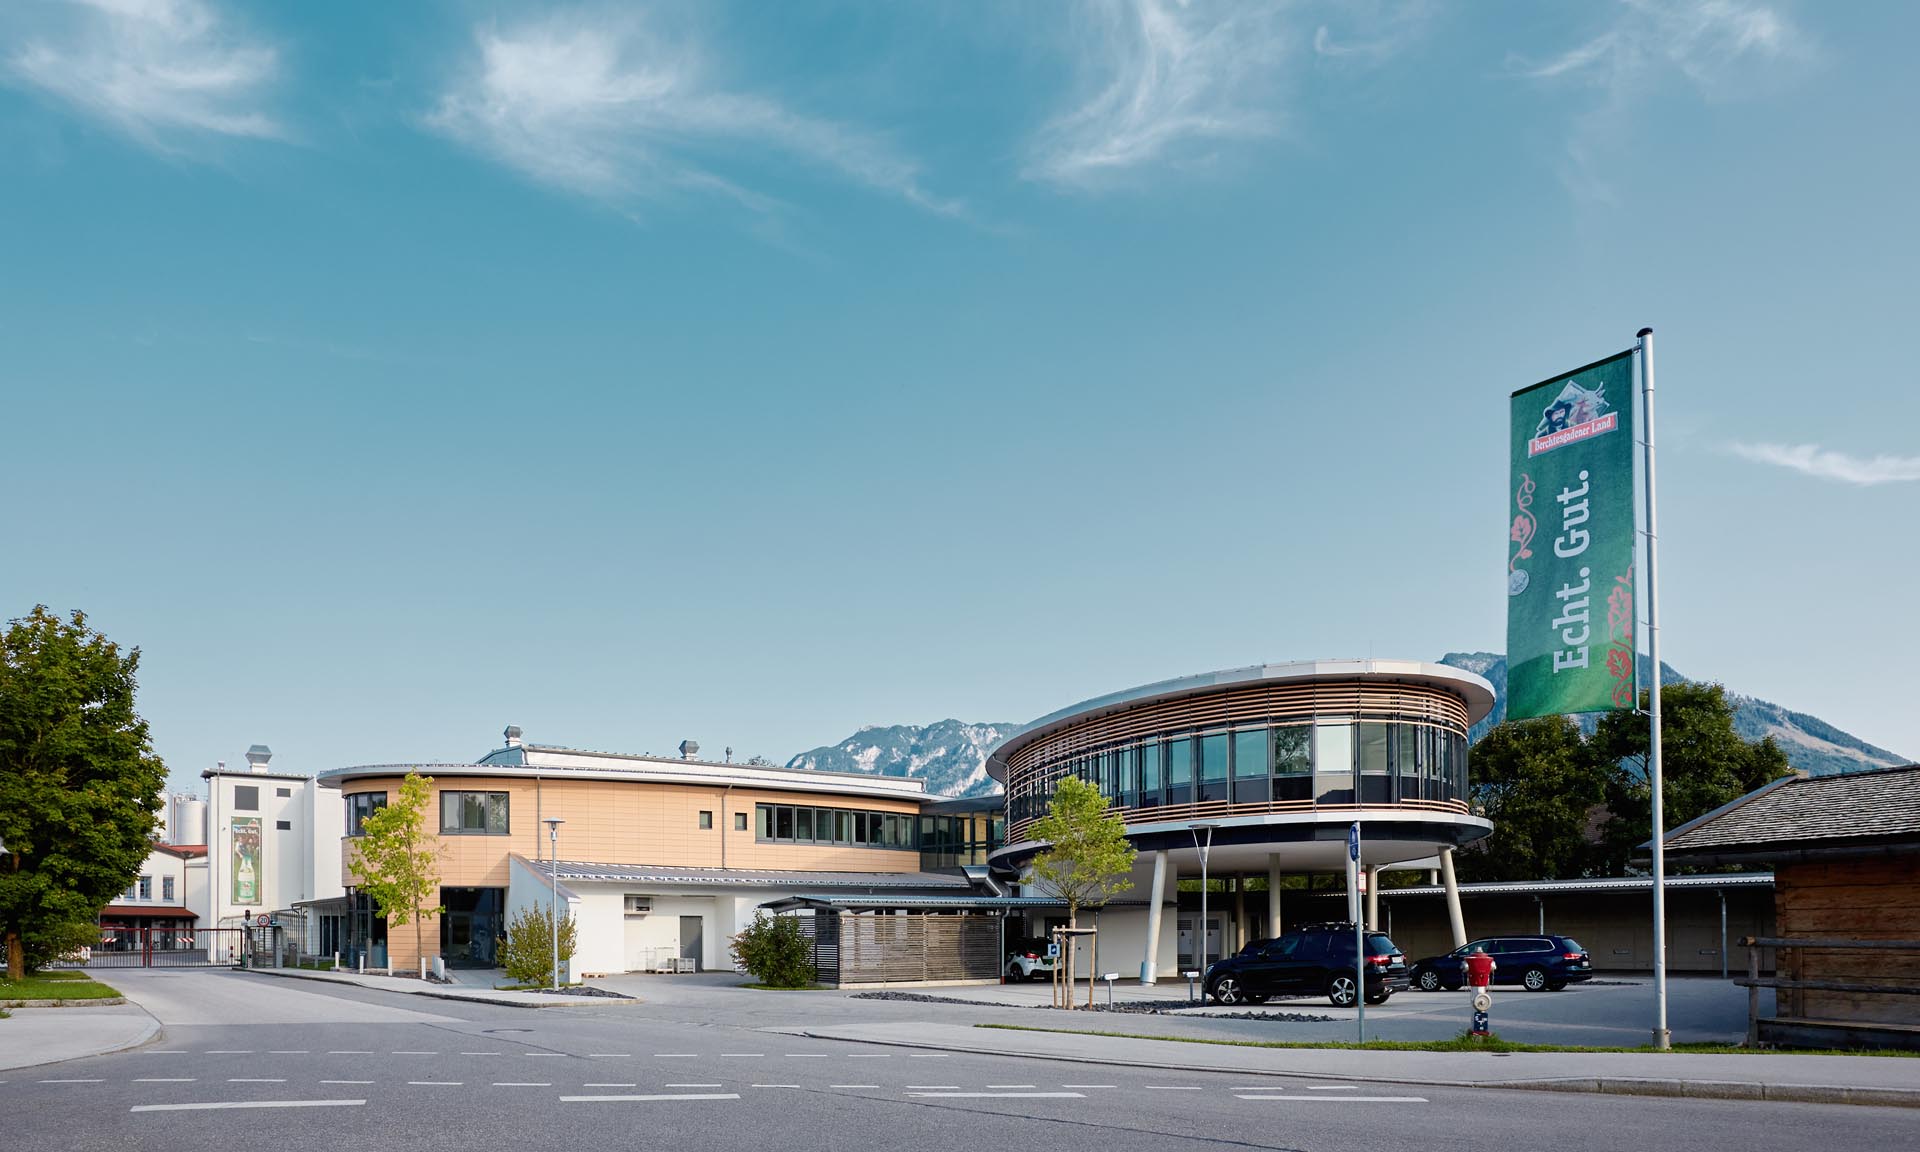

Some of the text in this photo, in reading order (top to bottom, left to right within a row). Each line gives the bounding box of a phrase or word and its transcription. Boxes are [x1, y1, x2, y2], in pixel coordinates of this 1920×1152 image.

[1534, 417, 1611, 451] Berchtesgadener Land
[1552, 470, 1590, 673] Echt. Gut.
